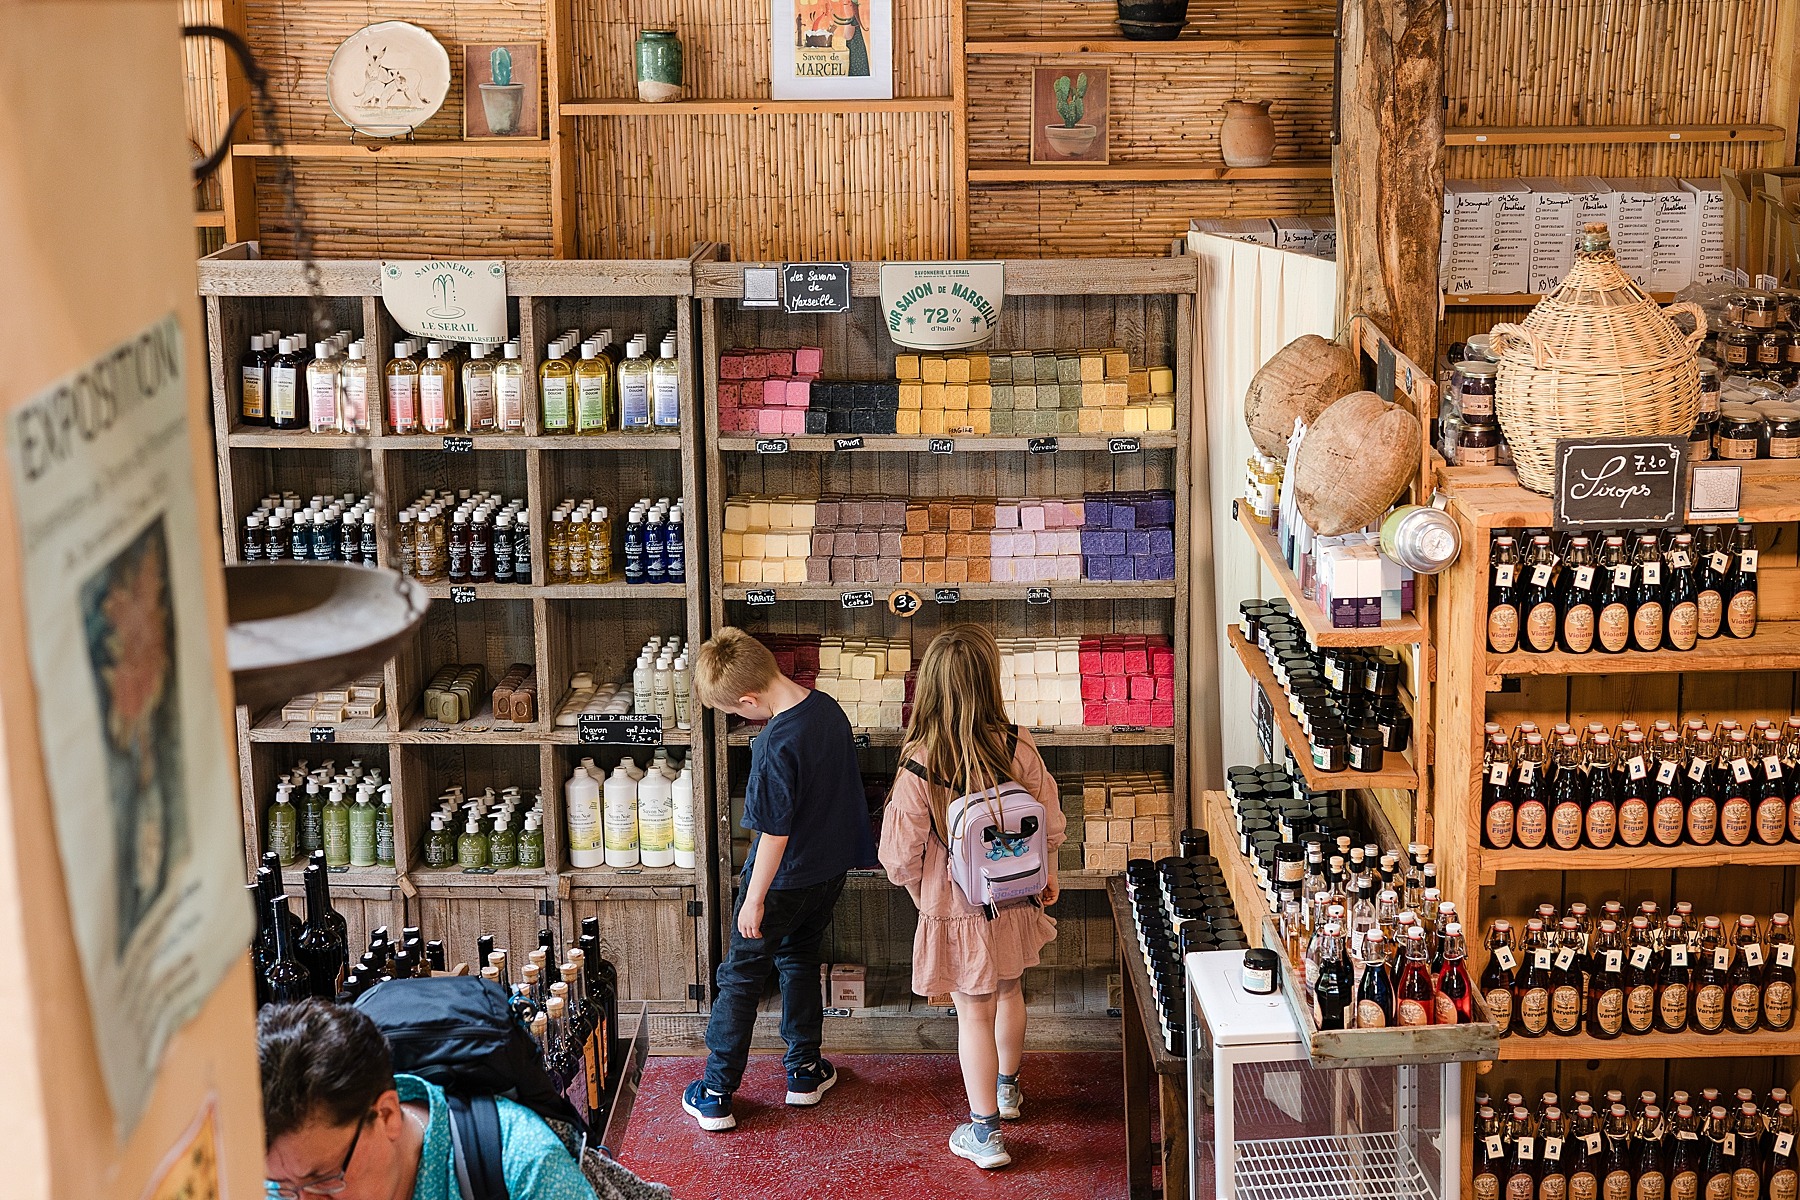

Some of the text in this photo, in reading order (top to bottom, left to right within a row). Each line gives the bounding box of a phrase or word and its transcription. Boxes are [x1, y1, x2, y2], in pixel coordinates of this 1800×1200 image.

[802, 53, 826, 61] Savon
[796, 62, 846, 77] MARCEL
[414, 261, 476, 279] SAVONNERIE
[807, 270, 837, 281] Savons
[808, 281, 823, 291] de
[889, 281, 997, 332] PUR SAVON DE MARSEILLE
[421, 322, 478, 332] LE SERAIL
[836, 438, 860, 447] PAVOT
[1112, 442, 1136, 450] Citron
[1570, 456, 1651, 508] Sirops
[625, 725, 638, 737] gel
[1521, 826, 1542, 834] Figue
[1692, 823, 1713, 831] Figue
[1762, 823, 1782, 831] Figue
